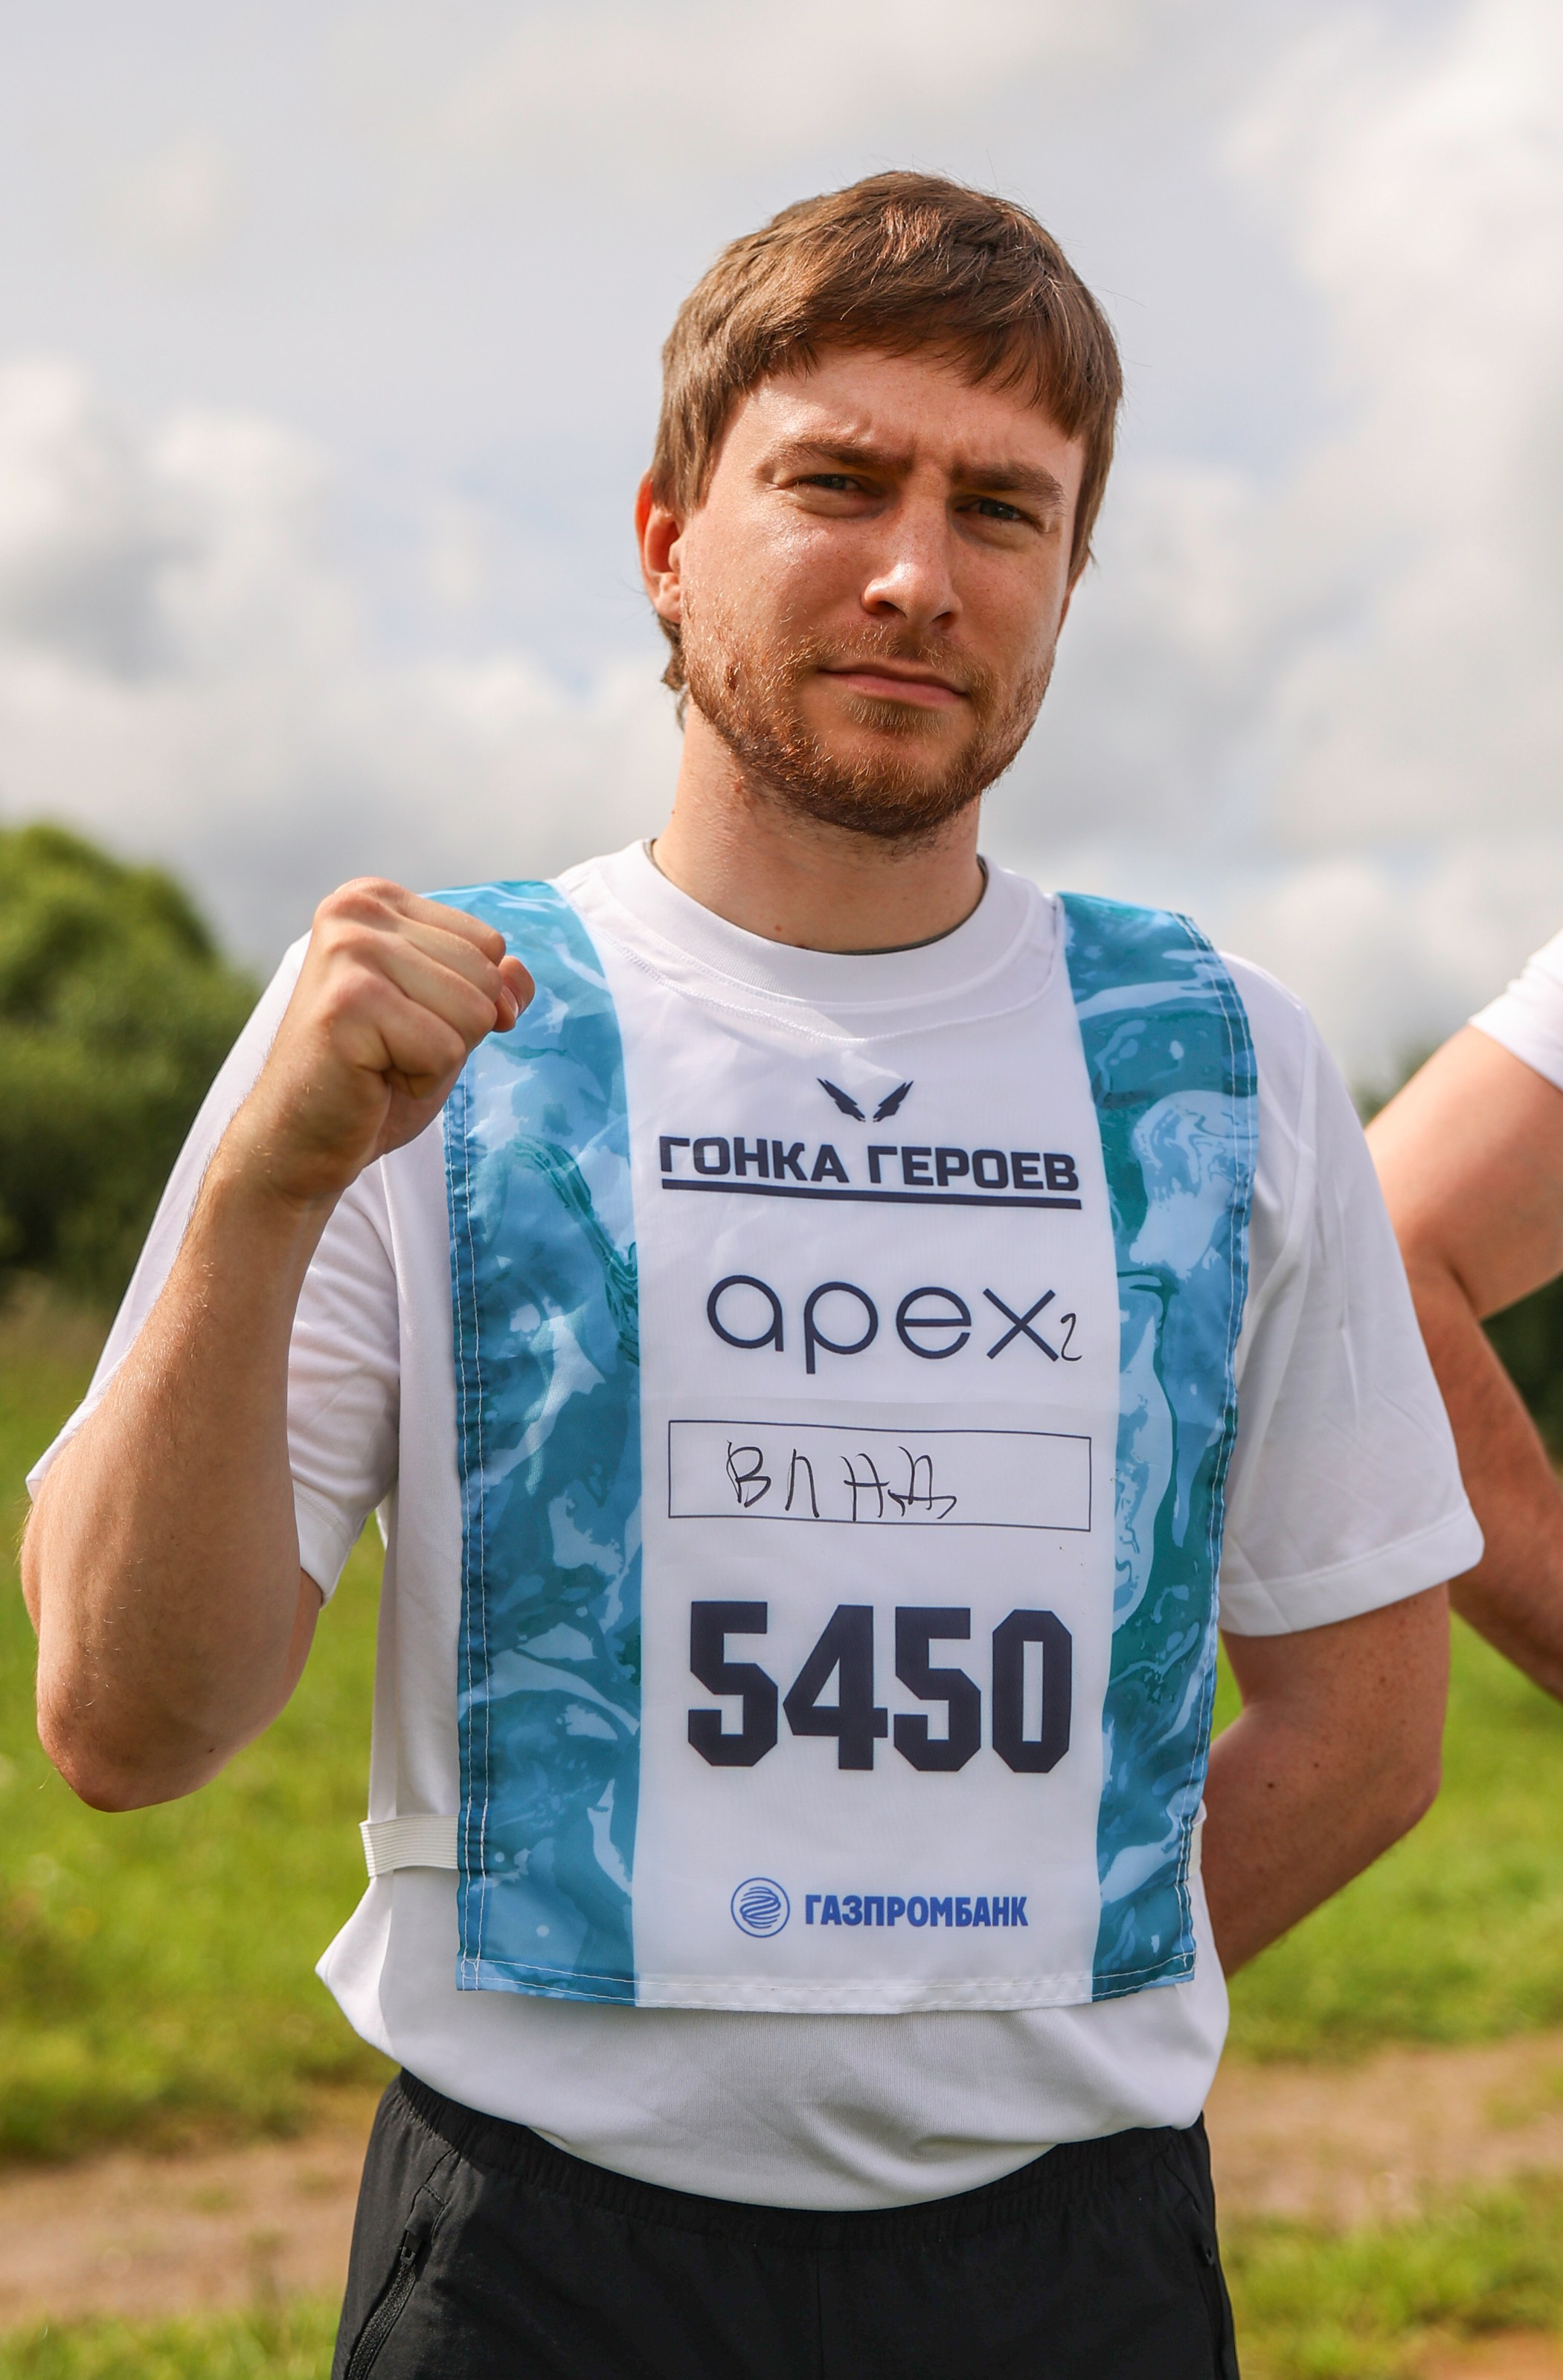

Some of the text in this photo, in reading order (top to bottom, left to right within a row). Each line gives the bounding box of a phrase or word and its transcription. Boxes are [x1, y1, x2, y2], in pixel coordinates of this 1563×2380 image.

[659, 1136, 1079, 1191] ГОНКА ГЕРОЕВ
[707, 1275, 1059, 1374] apex
[1060, 1313, 1082, 1362] 2
[688, 1601, 1072, 1774] 5450
[805, 1894, 1028, 1927] ГАЗПРОМБАНК
